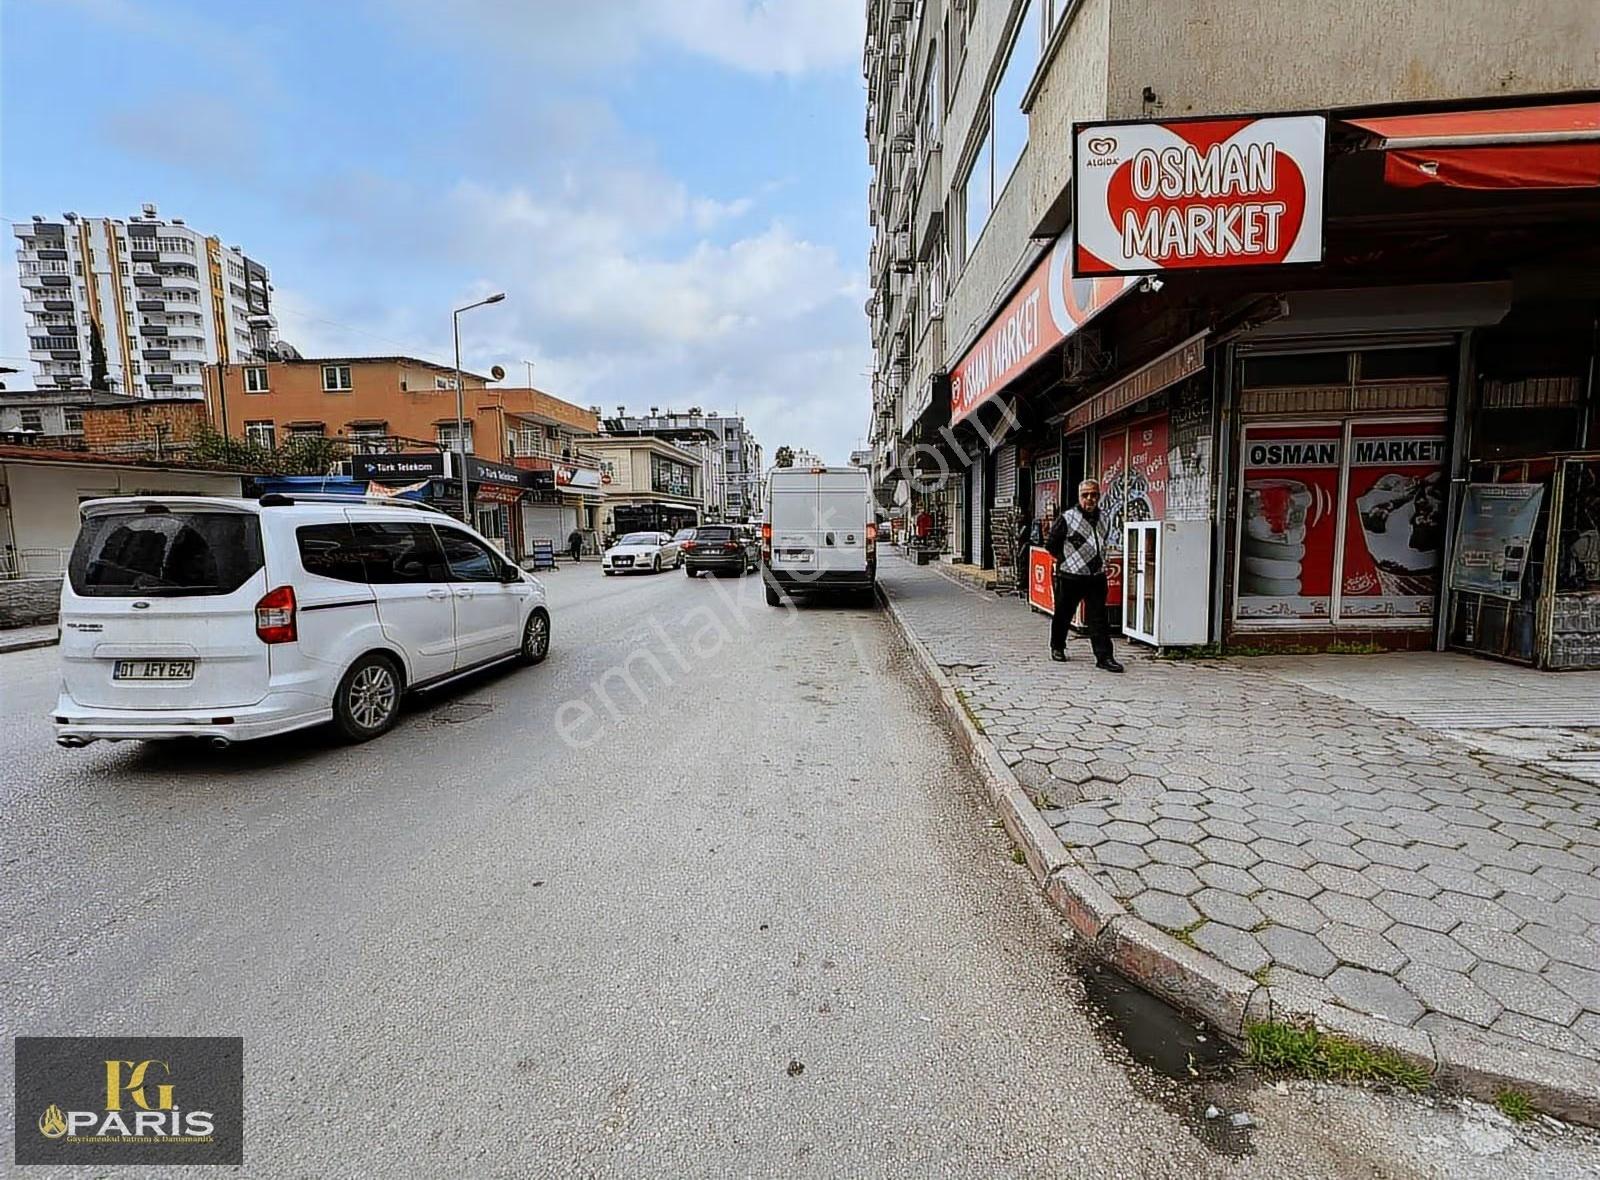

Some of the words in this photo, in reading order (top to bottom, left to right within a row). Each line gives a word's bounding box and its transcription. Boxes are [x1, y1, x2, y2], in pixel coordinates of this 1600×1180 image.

[1087, 158, 1118, 167] ALGIDA
[1132, 143, 1274, 200] OSMAN
[1123, 202, 1285, 259] MARKET
[962, 343, 991, 408] OSMAN
[991, 287, 1041, 382] MARKET
[1250, 441, 1336, 465] OSMAN
[1356, 439, 1446, 463] MARKET
[377, 463, 396, 471] Türk
[398, 463, 433, 471] Telekom
[120, 662, 134, 677] 01
[143, 662, 166, 676] AFY
[168, 661, 191, 677] 624
